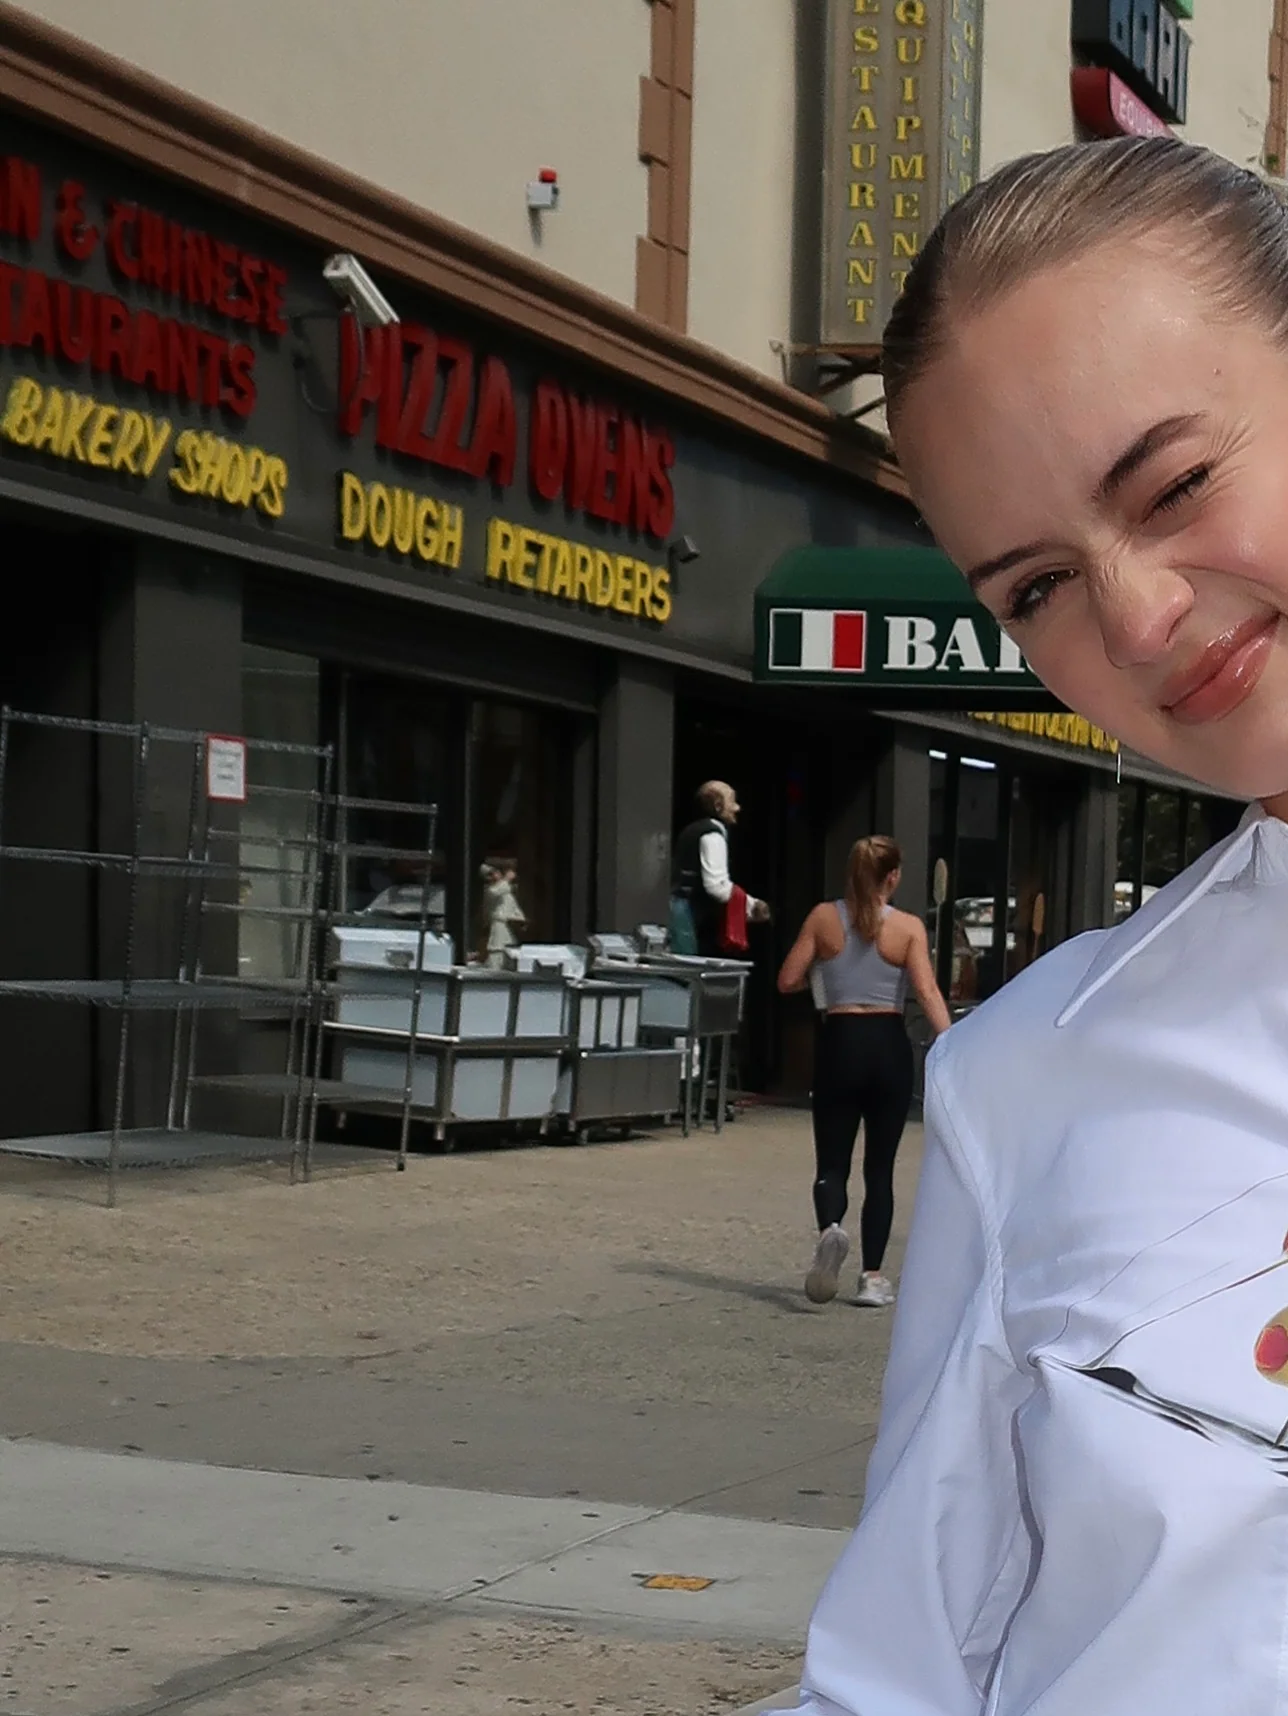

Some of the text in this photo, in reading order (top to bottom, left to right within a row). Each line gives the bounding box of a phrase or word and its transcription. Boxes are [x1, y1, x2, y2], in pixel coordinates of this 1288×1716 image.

[59, 180, 98, 260] &
[106, 198, 288, 336] CHINESE
[2, 376, 288, 519] BAKERY SHOPS
[340, 311, 676, 541] PIZZA OVENS
[341, 472, 672, 625] DOUGH RETARDERS
